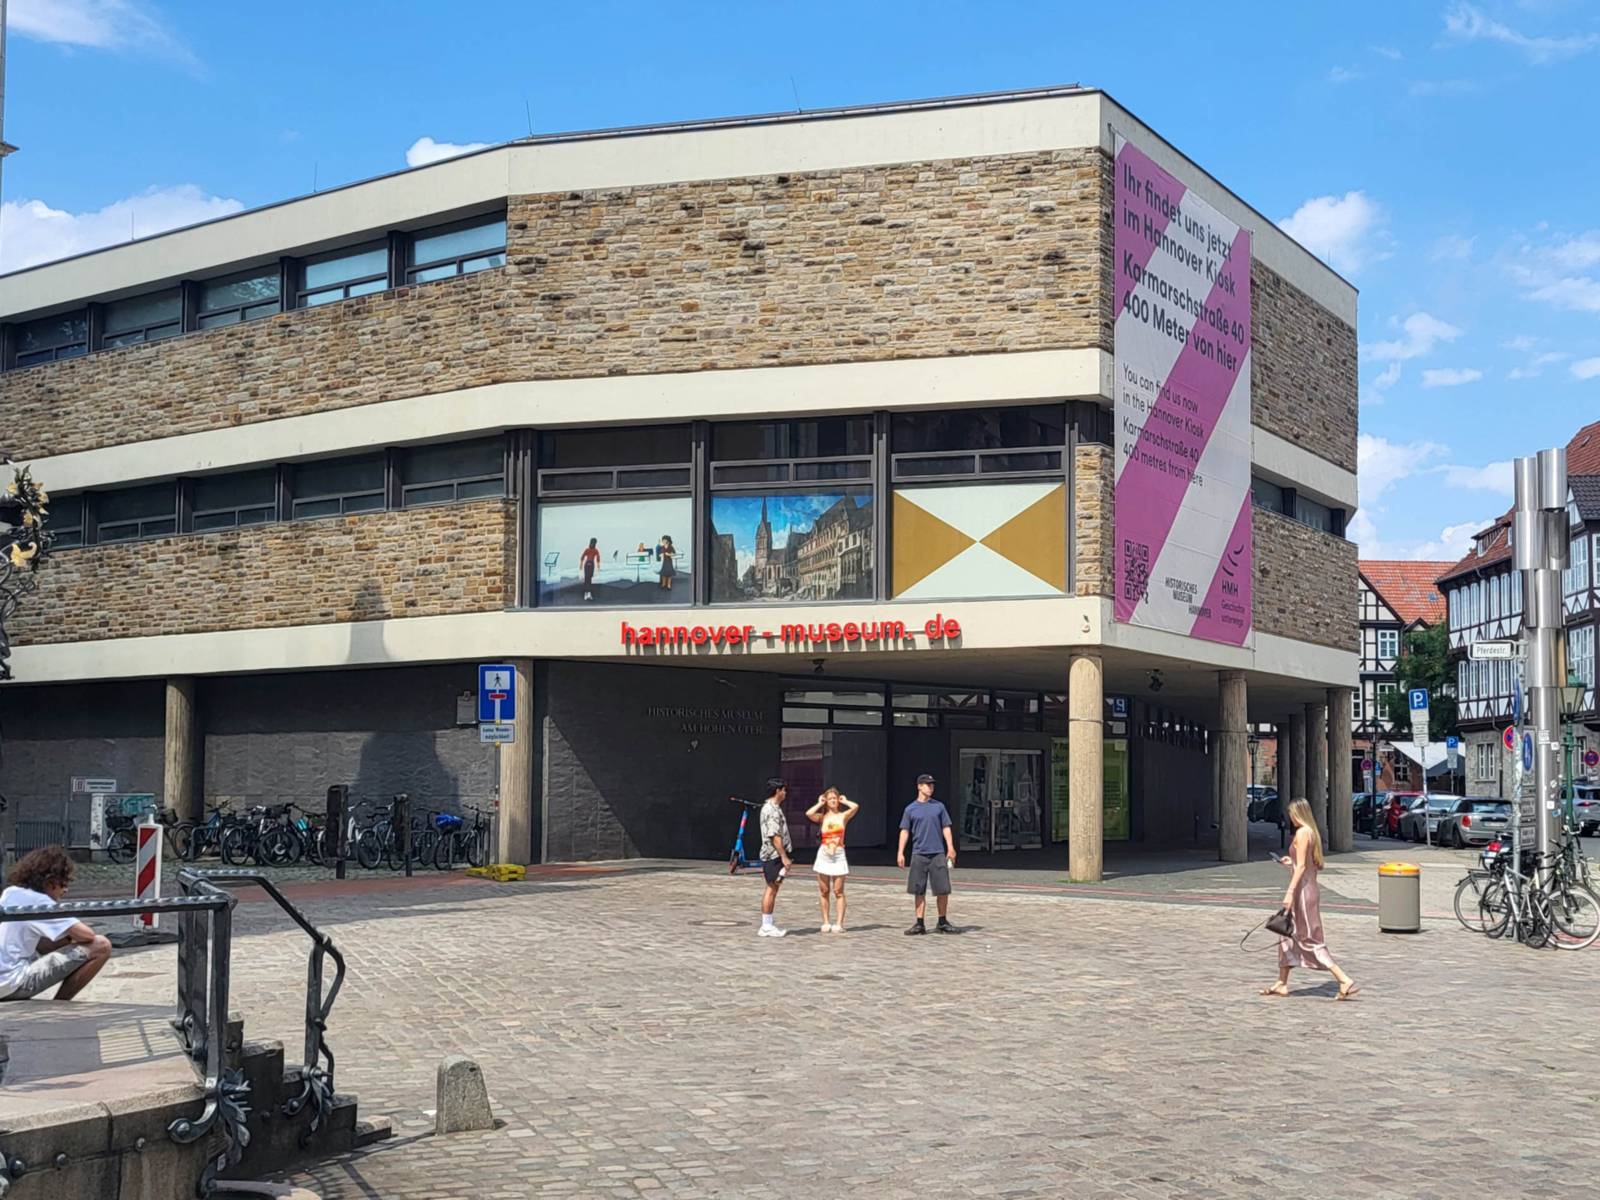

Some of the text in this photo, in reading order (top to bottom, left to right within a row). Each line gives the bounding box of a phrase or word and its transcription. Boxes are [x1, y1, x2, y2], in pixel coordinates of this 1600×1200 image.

[1123, 163, 1232, 262] Ihr findet uns jetzt
[1123, 200, 1236, 297] im Hannover Kiosk
[1123, 249, 1244, 344] Karmarschstraße 40
[1123, 290, 1237, 372] 400 Meter von hier
[1122, 363, 1198, 414] You can find us now
[1122, 387, 1204, 437] in the Hannover Kiosk
[1123, 416, 1200, 463] Karmarschstraße 40
[1123, 442, 1204, 487] 400 metres from here
[1164, 577, 1198, 595] HISTORISCHES
[1172, 589, 1193, 604] MUSEUM
[1221, 580, 1239, 597] HMH
[620, 621, 753, 646] hannover
